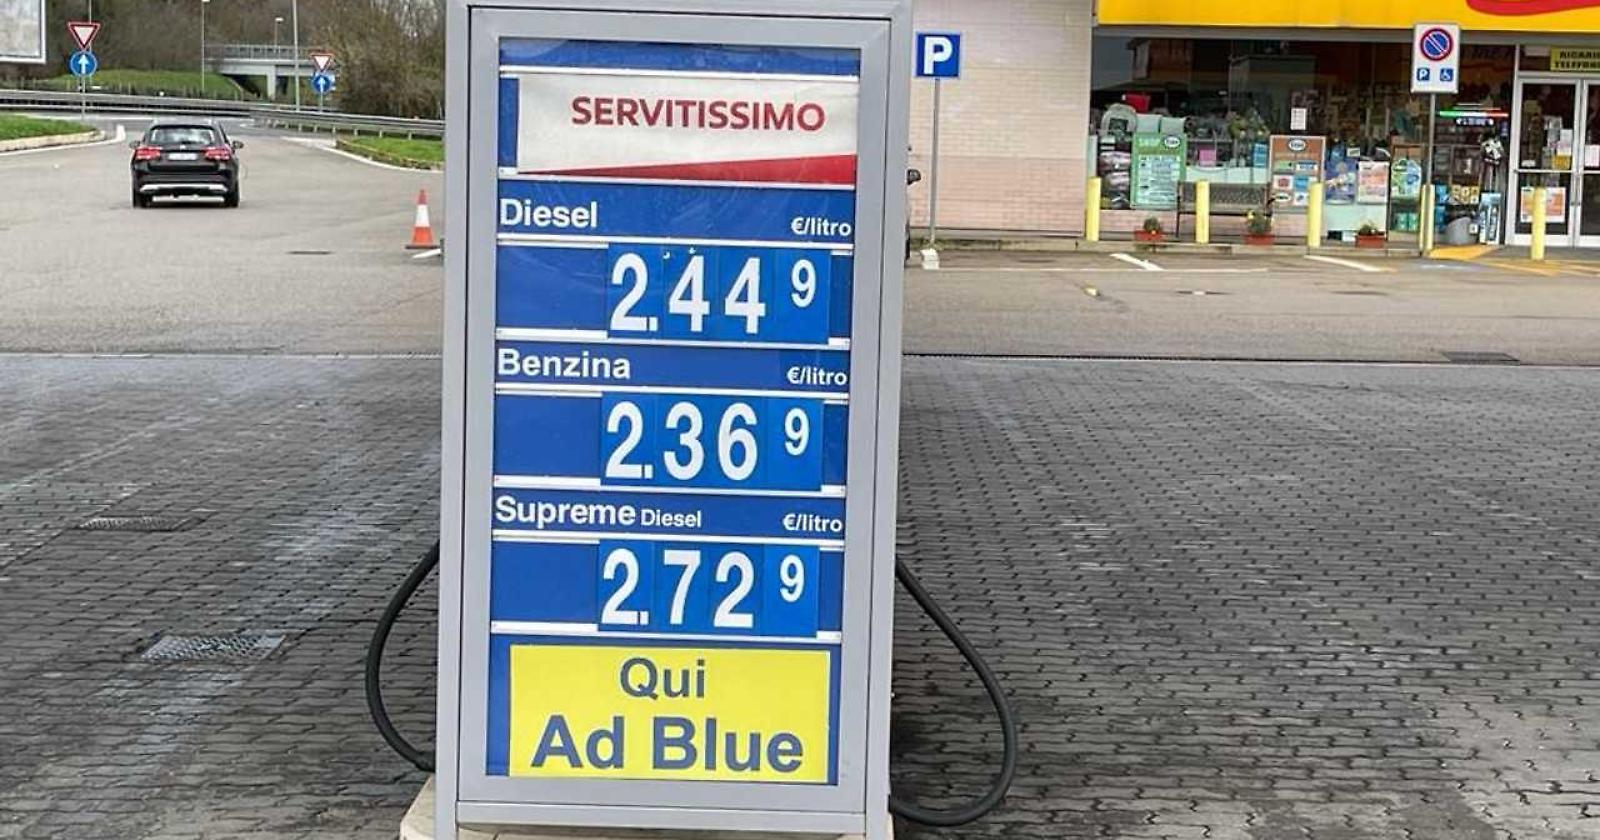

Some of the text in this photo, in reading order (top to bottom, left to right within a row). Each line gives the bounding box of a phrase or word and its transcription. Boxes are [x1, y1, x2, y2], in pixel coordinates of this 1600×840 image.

[922, 36, 954, 75] P
[1419, 68, 1429, 80] P
[571, 96, 826, 132] SERVITISSIMO
[499, 198, 598, 229] Diesel
[790, 217, 852, 237] €/litro
[497, 348, 631, 380] Benzina
[786, 366, 848, 386] €/litro
[495, 495, 702, 529] Supreme Diesel
[782, 514, 843, 533] €/litro
[619, 657, 705, 700] Qui
[531, 715, 803, 774] Ad Blue
